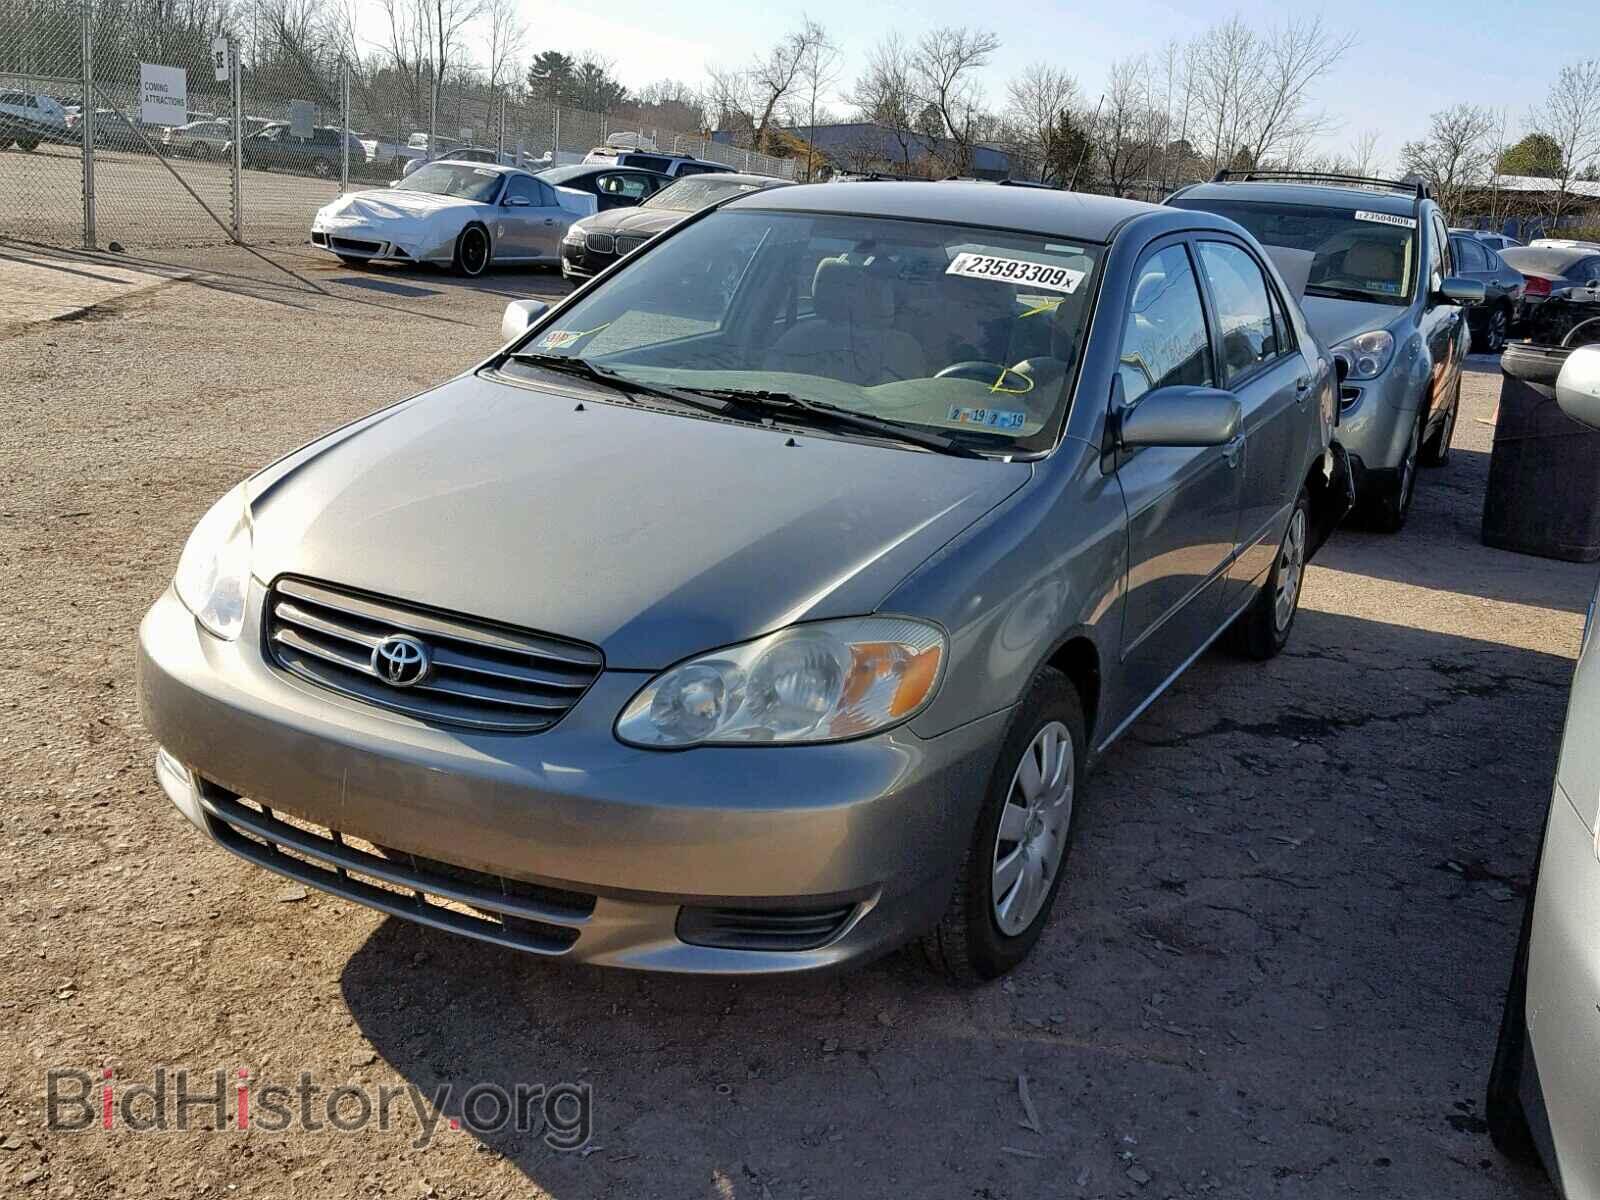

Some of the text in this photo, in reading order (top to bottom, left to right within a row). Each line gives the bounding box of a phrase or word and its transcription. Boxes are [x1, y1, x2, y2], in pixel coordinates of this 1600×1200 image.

[145, 82, 168, 92] COMING
[144, 95, 185, 106] ATTRACTIONS
[966, 256, 1067, 286] 23593309
[973, 409, 985, 421] 19
[1012, 414, 1023, 427] 19
